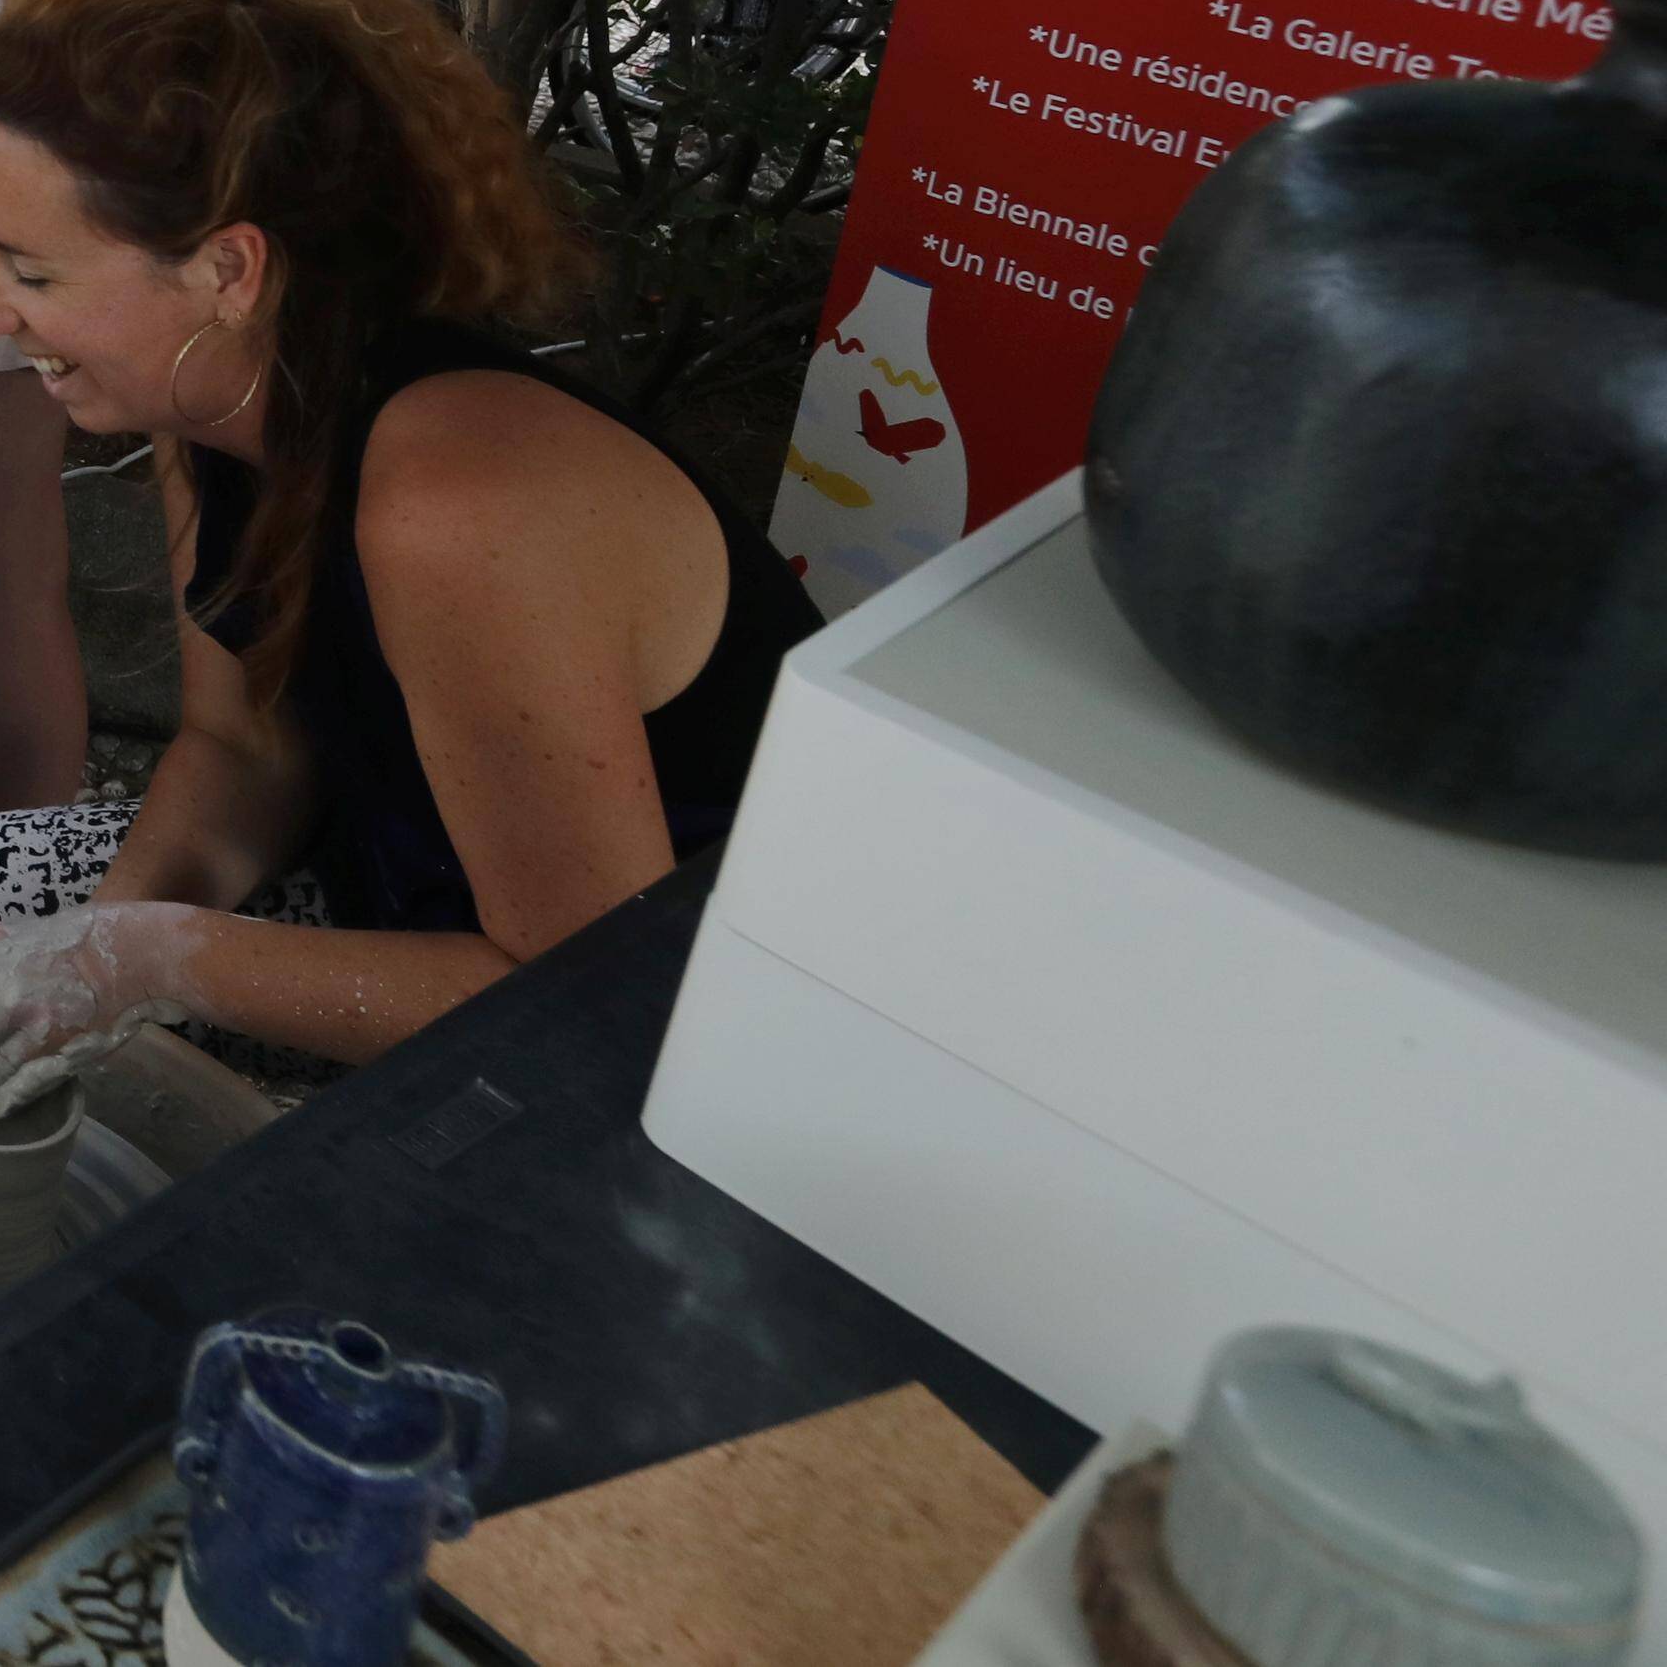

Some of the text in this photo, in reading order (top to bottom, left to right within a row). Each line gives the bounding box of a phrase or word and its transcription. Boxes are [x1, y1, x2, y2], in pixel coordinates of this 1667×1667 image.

[1284, 18, 1436, 81] Galerie
[1040, 95, 1188, 159] Festival
[973, 186, 1129, 258] Biennale
[994, 256, 1060, 301] lieu
[1068, 284, 1115, 321] de
